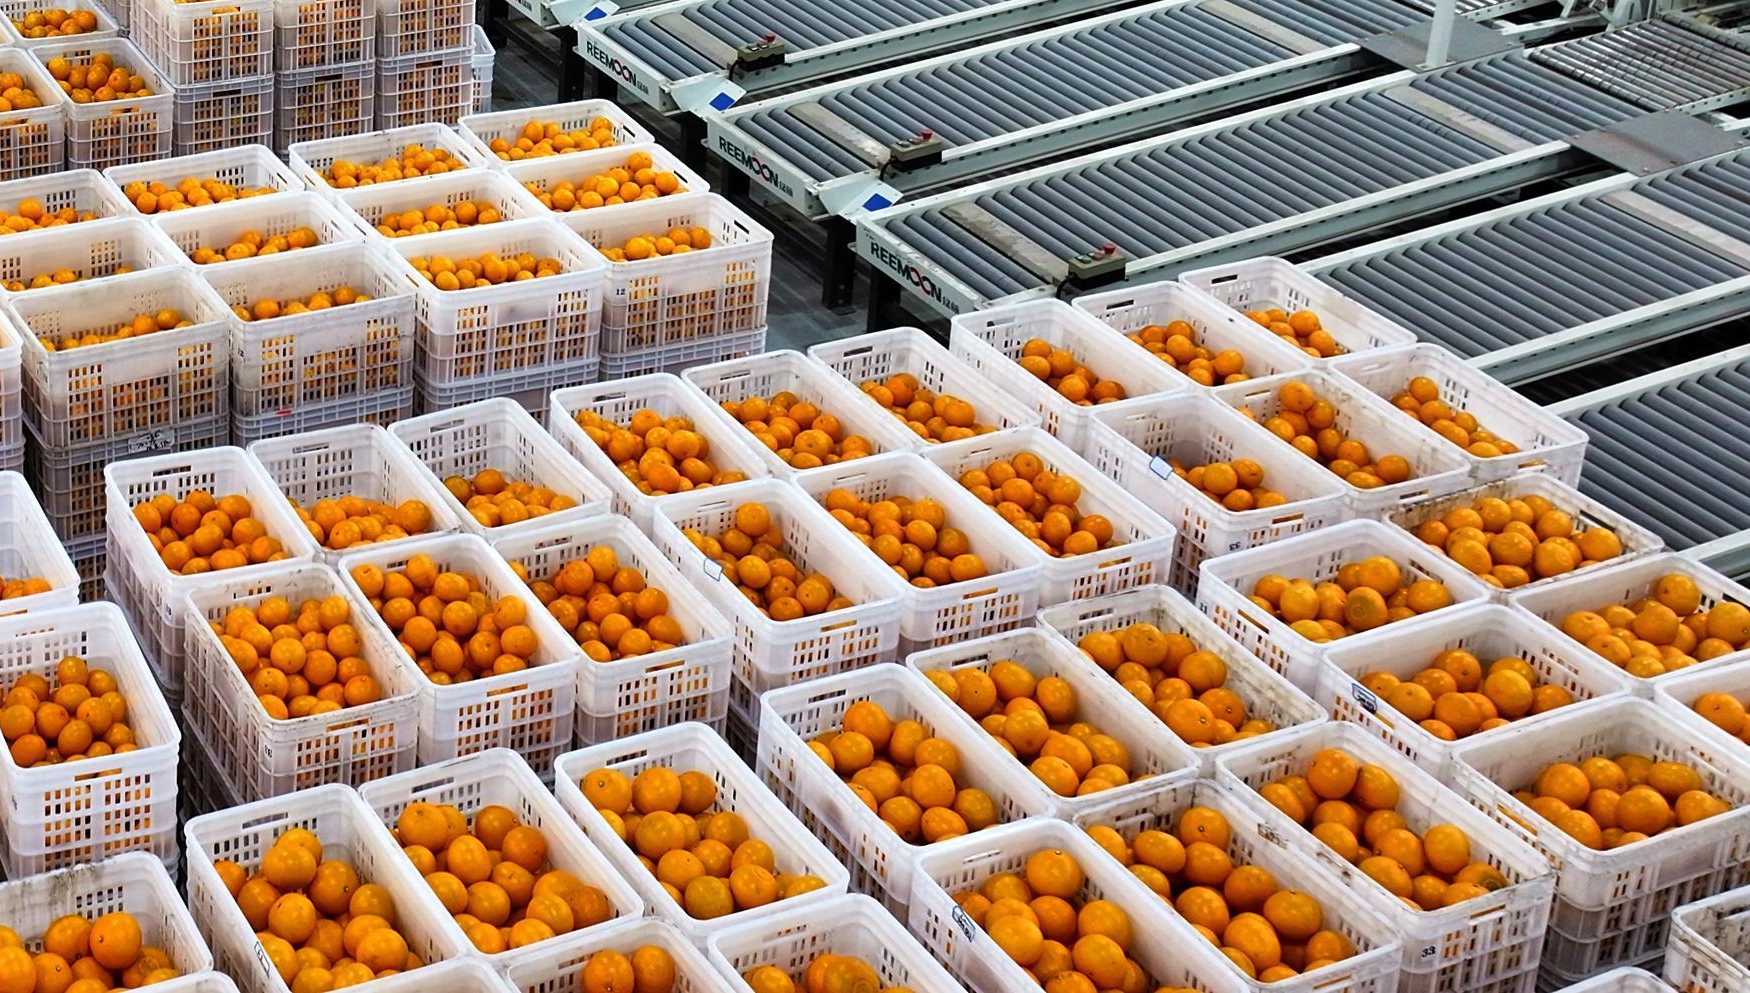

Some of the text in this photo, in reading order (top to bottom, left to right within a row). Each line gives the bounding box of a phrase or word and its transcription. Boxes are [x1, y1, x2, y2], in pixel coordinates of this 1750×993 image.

[587, 41, 637, 86] REEMOON
[719, 136, 779, 187] REEMOON
[871, 242, 942, 303] REEMOON
[1421, 945, 1436, 958] 33
